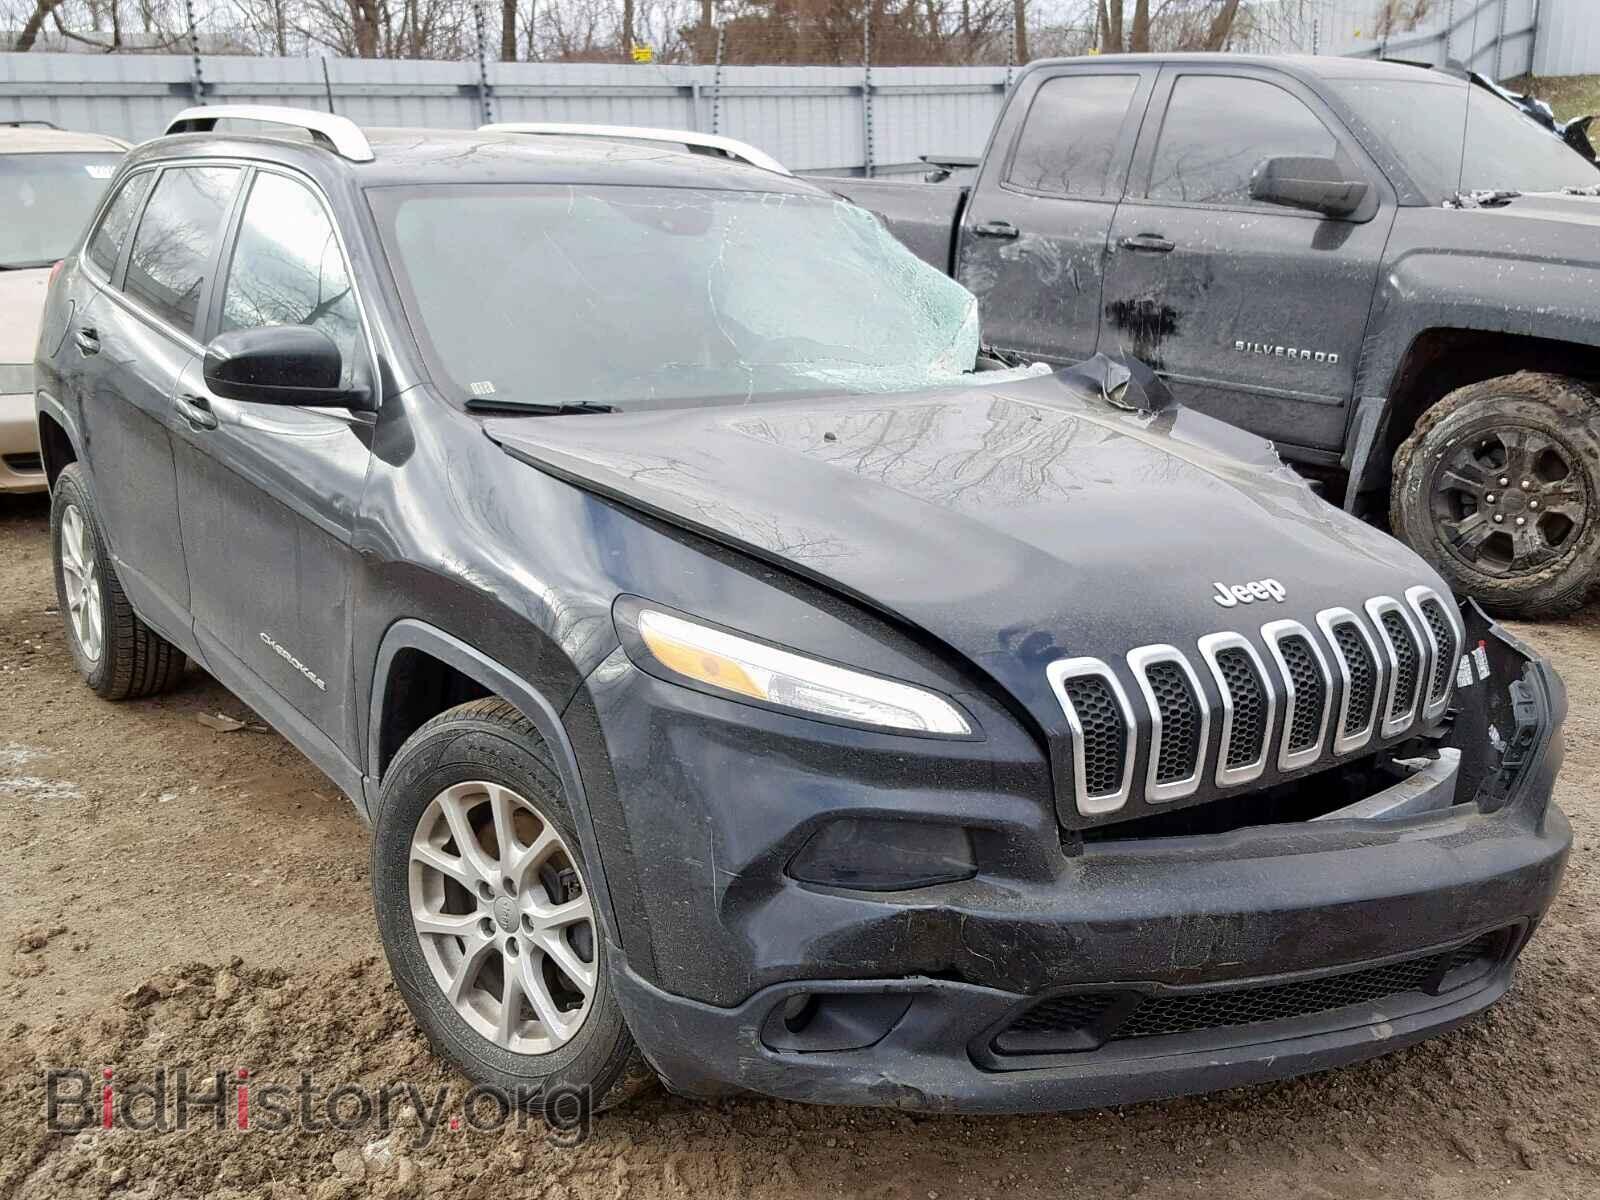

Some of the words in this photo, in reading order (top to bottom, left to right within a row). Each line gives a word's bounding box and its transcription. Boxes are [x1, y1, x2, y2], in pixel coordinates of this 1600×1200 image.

[1234, 340, 1339, 364] SILVERADO
[1213, 578, 1286, 607] Jeep
[259, 632, 326, 691] CHEROKEE
